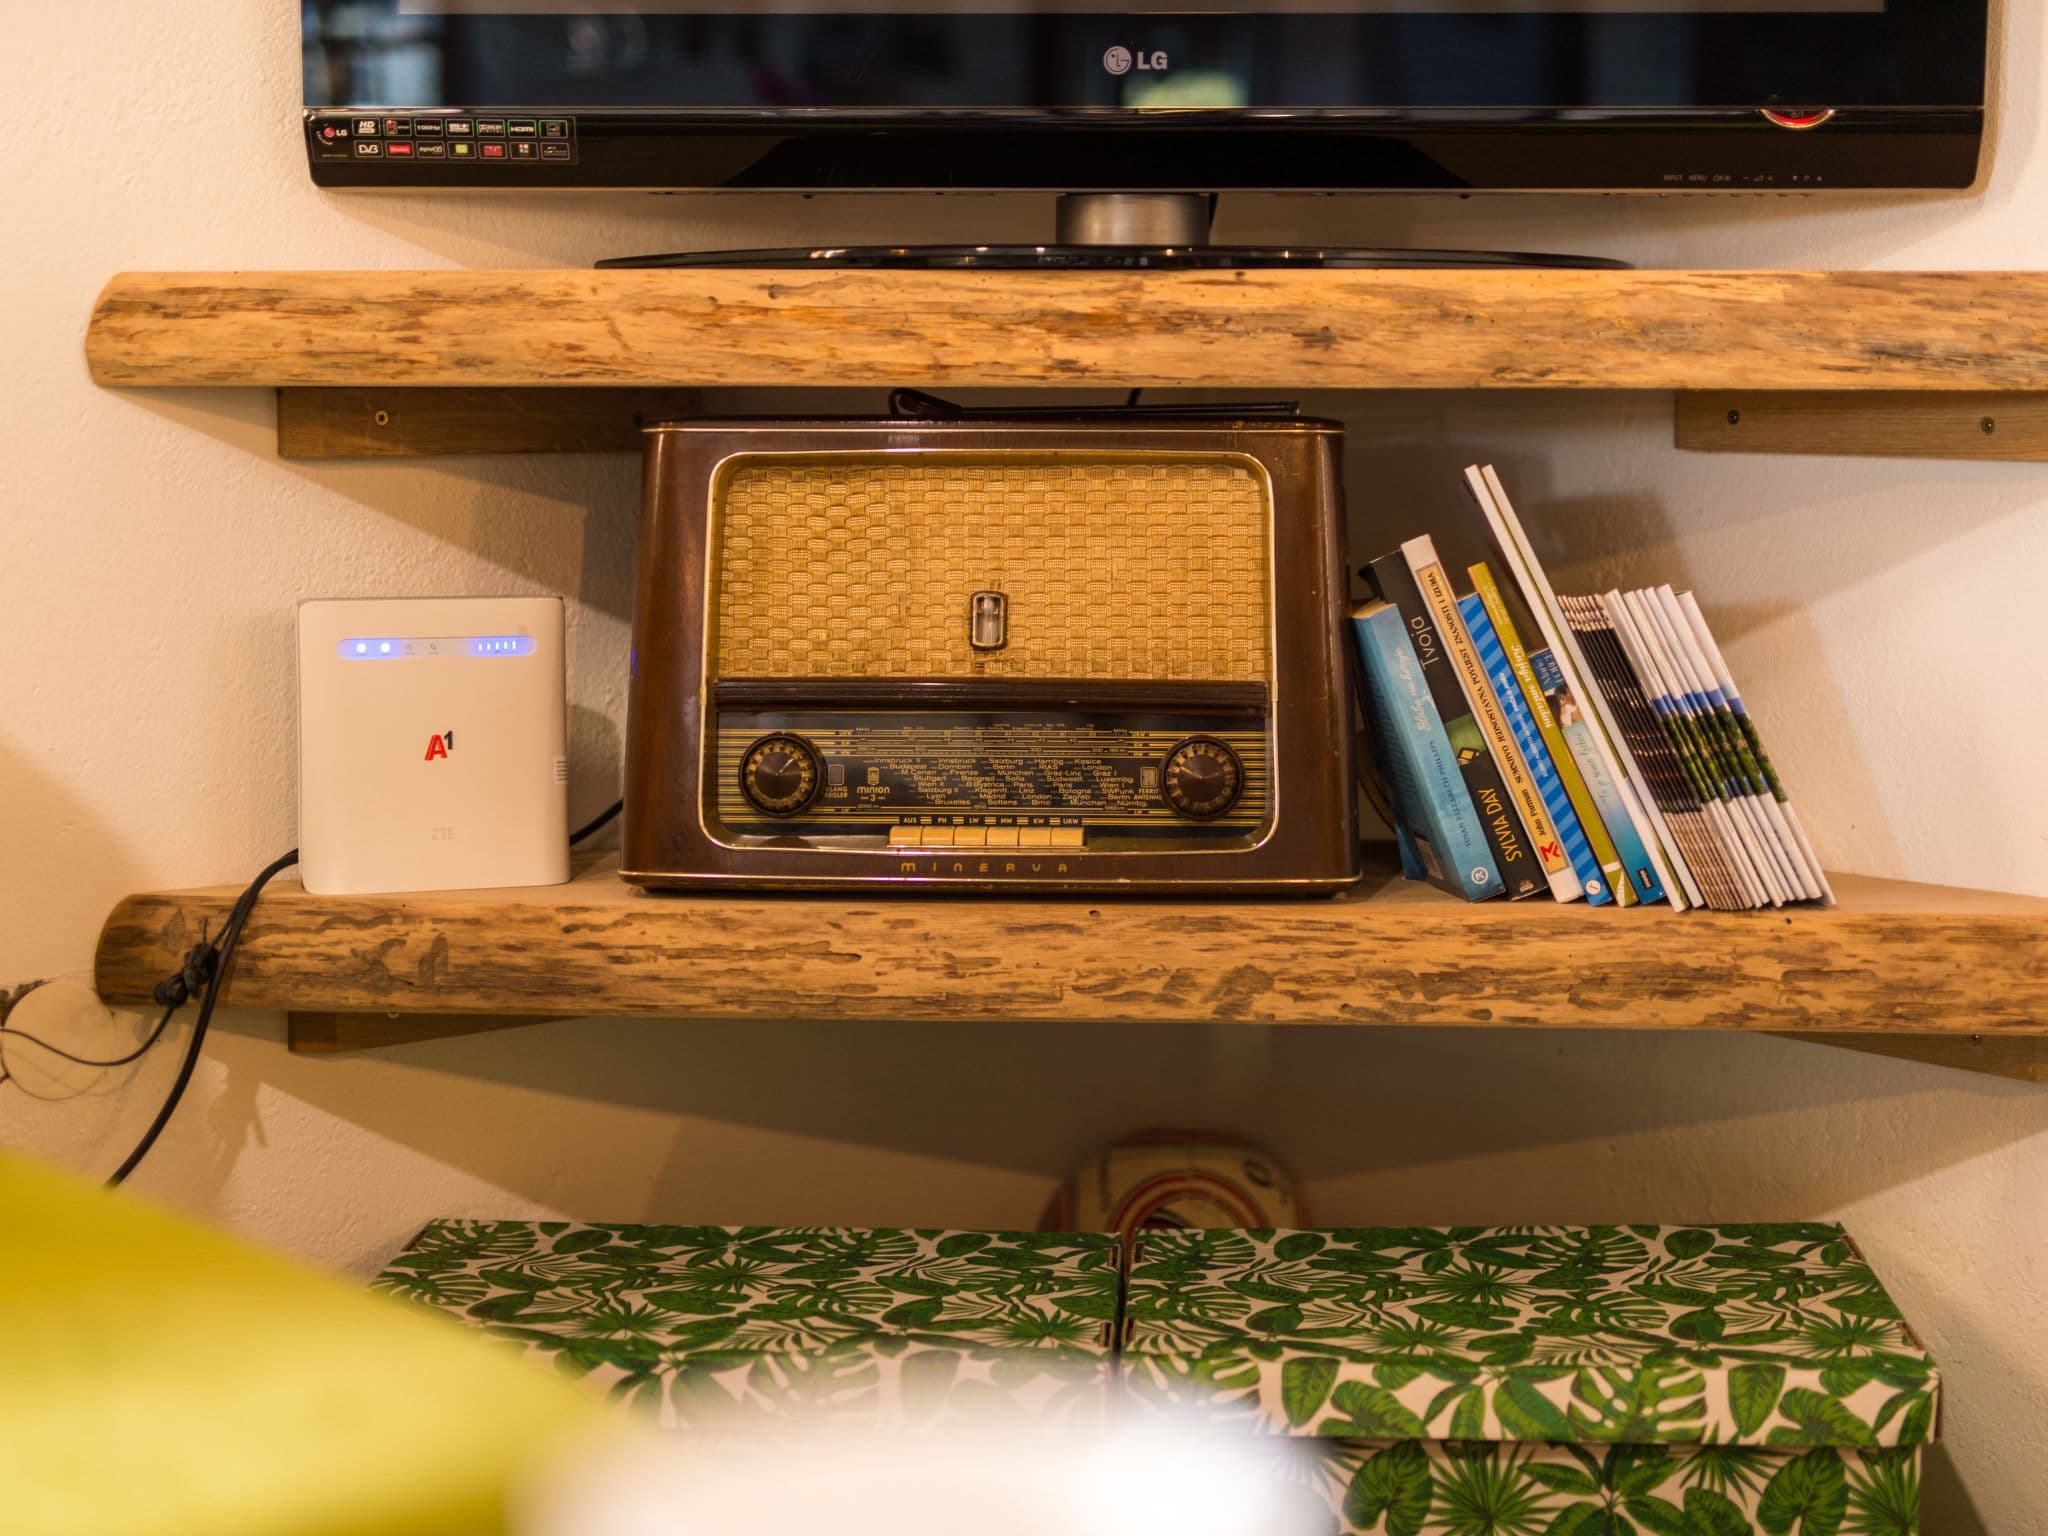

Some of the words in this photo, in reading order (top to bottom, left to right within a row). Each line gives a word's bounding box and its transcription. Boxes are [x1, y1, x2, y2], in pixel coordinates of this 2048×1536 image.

[1137, 51, 1168, 71] LG
[336, 129, 348, 137] LG
[358, 144, 379, 154] DVB
[1427, 572, 1444, 598] IZUMA
[1440, 605, 1464, 646] ZNANOSTI
[1409, 614, 1440, 671] Tvoja
[1458, 647, 1481, 685] POVIJEST
[1509, 643, 1533, 683] Knjiga
[1475, 686, 1506, 744] JEDNOSTAVNA
[424, 730, 454, 761] A1
[989, 758, 1025, 766] Salzburg
[1501, 744, 1523, 784] SUMNJIVO
[914, 775, 947, 783] Stuttgart
[857, 786, 890, 794] minion
[870, 794, 877, 802] 3
[917, 787, 953, 795] Salzburg
[926, 793, 946, 801] Lyon
[1058, 788, 1092, 796] Bologna
[1062, 794, 1092, 802] Zagreb
[1477, 784, 1503, 815] DAY
[431, 827, 456, 841] ZTE
[1532, 818, 1547, 837] John
[1490, 814, 1524, 863] SYLVIA
